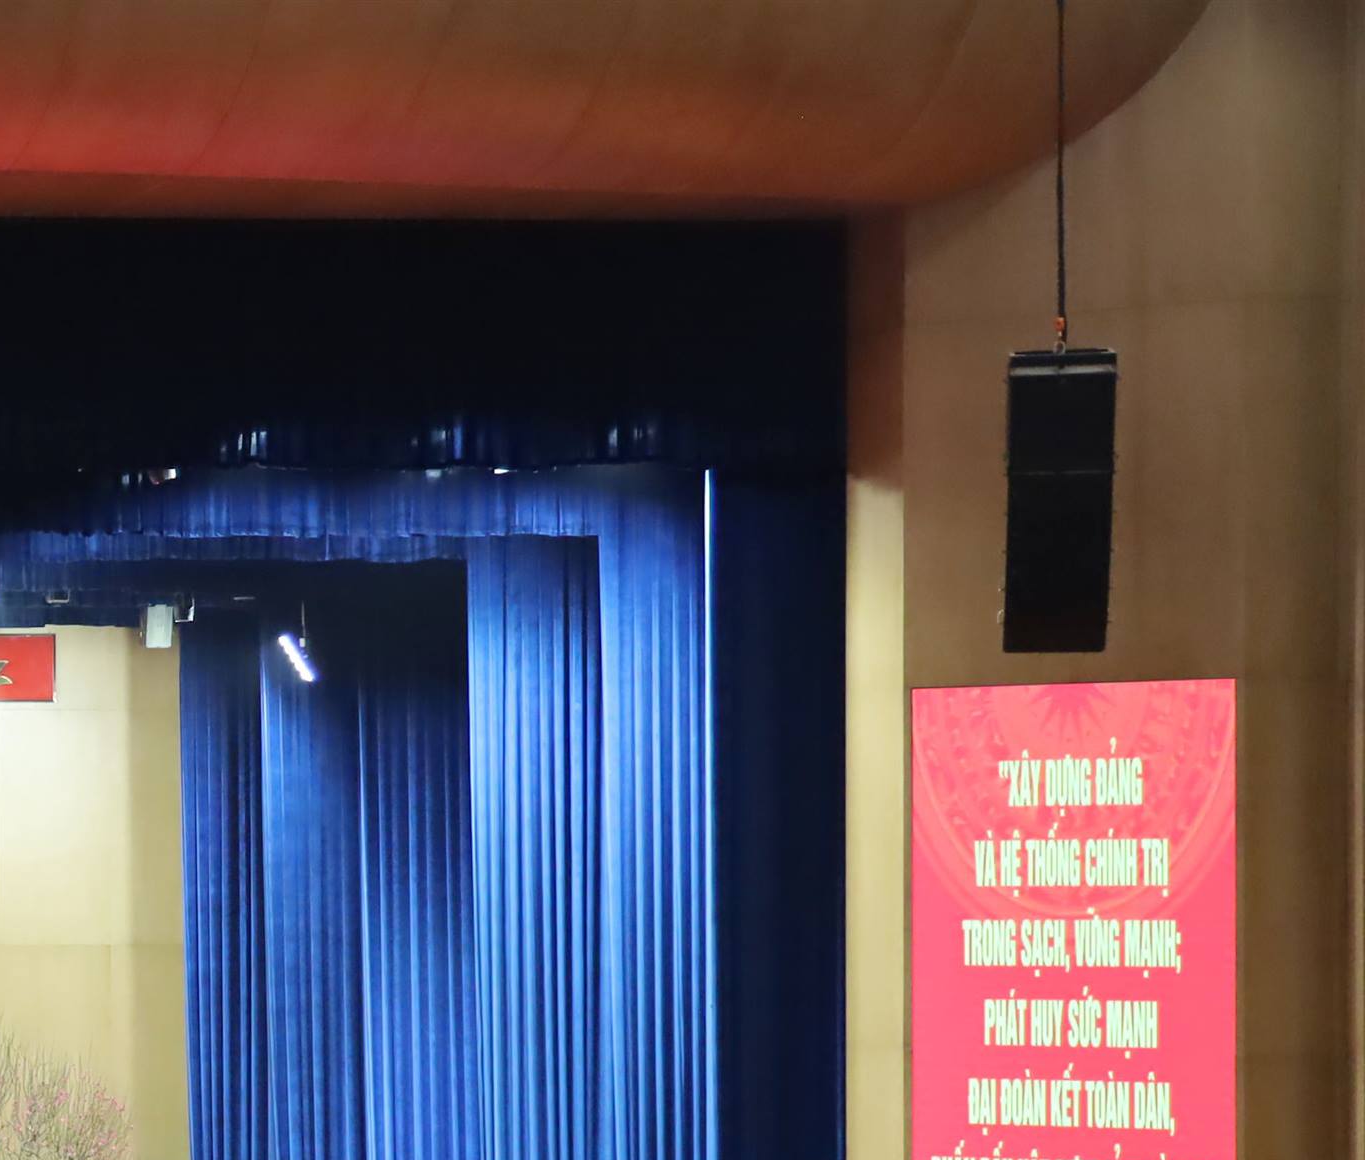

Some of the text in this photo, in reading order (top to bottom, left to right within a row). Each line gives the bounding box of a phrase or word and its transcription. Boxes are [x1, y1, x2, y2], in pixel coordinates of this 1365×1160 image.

[1045, 754, 1092, 816] DỰNG
[1095, 737, 1143, 806] ĐẢNG
[974, 822, 1170, 897] VÀ HỆ THỐNG CHÍNH TRỊ
[962, 919, 1016, 966] TRONG
[1021, 919, 1070, 977] SẠCH,
[1125, 920, 1181, 978] MẠNH;
[984, 986, 1157, 1058] PHÁT HUY SỨC MẠNH
[968, 1063, 1175, 1136] ĐẠI ĐOÀN KẾT TOÀN DÂN,
